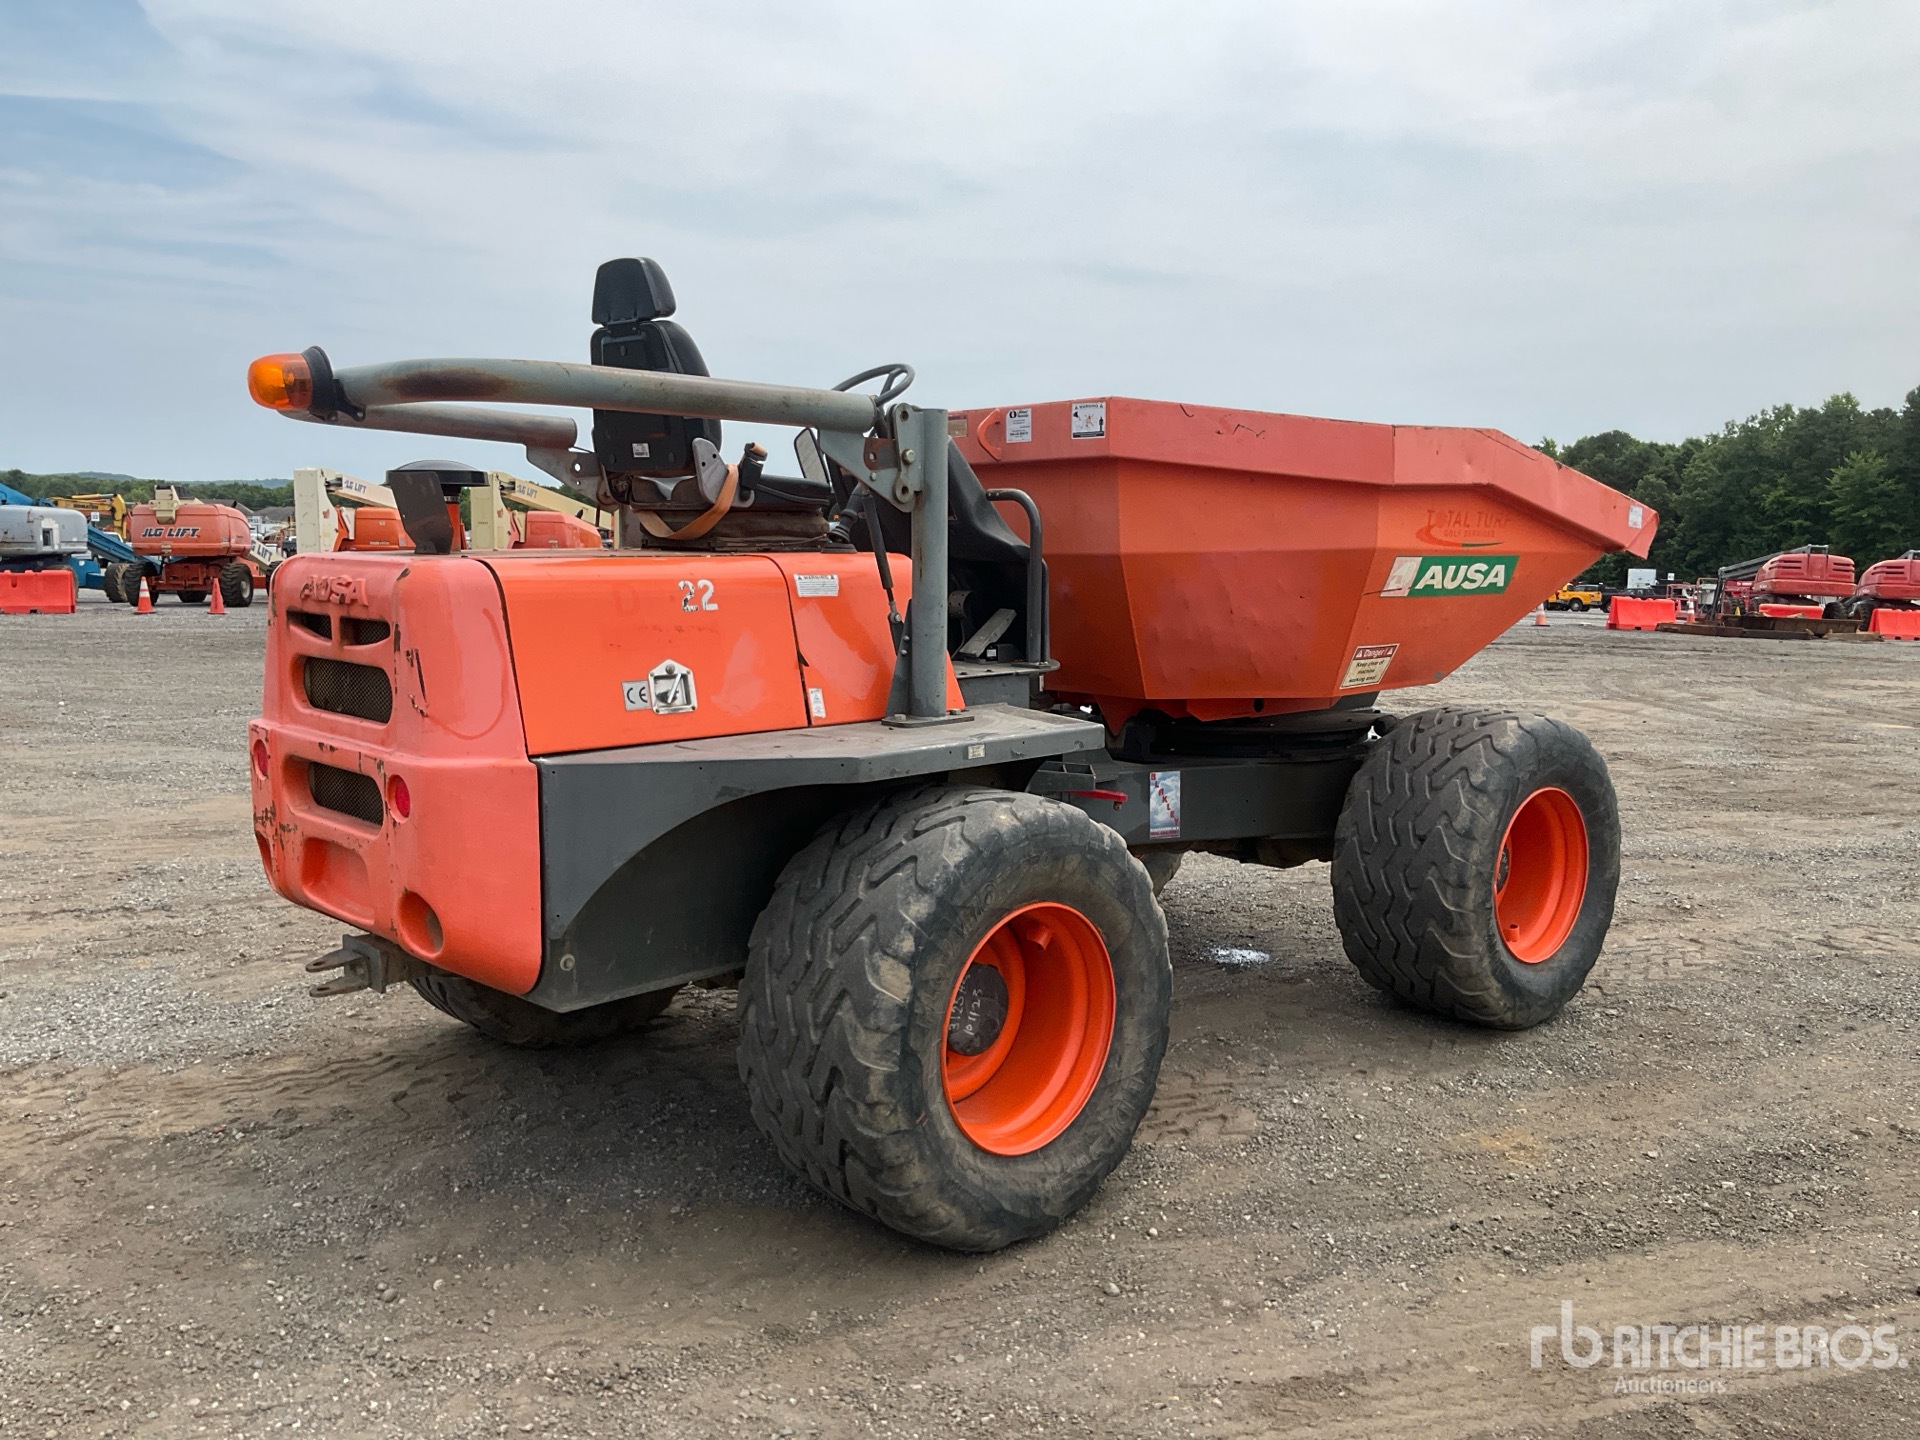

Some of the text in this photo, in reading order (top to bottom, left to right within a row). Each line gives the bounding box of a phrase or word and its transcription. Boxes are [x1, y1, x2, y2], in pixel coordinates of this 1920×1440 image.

[354, 482, 367, 494] LIFT
[526, 487, 538, 498] LIFT
[141, 526, 200, 538] JLG LIFT
[1414, 563, 1506, 590] AUSA
[300, 575, 369, 607] AUSA
[678, 579, 719, 612] 22
[1363, 648, 1389, 659] Danger!
[626, 686, 649, 705] CE
[1150, 773, 1179, 826] BLAKLEY
